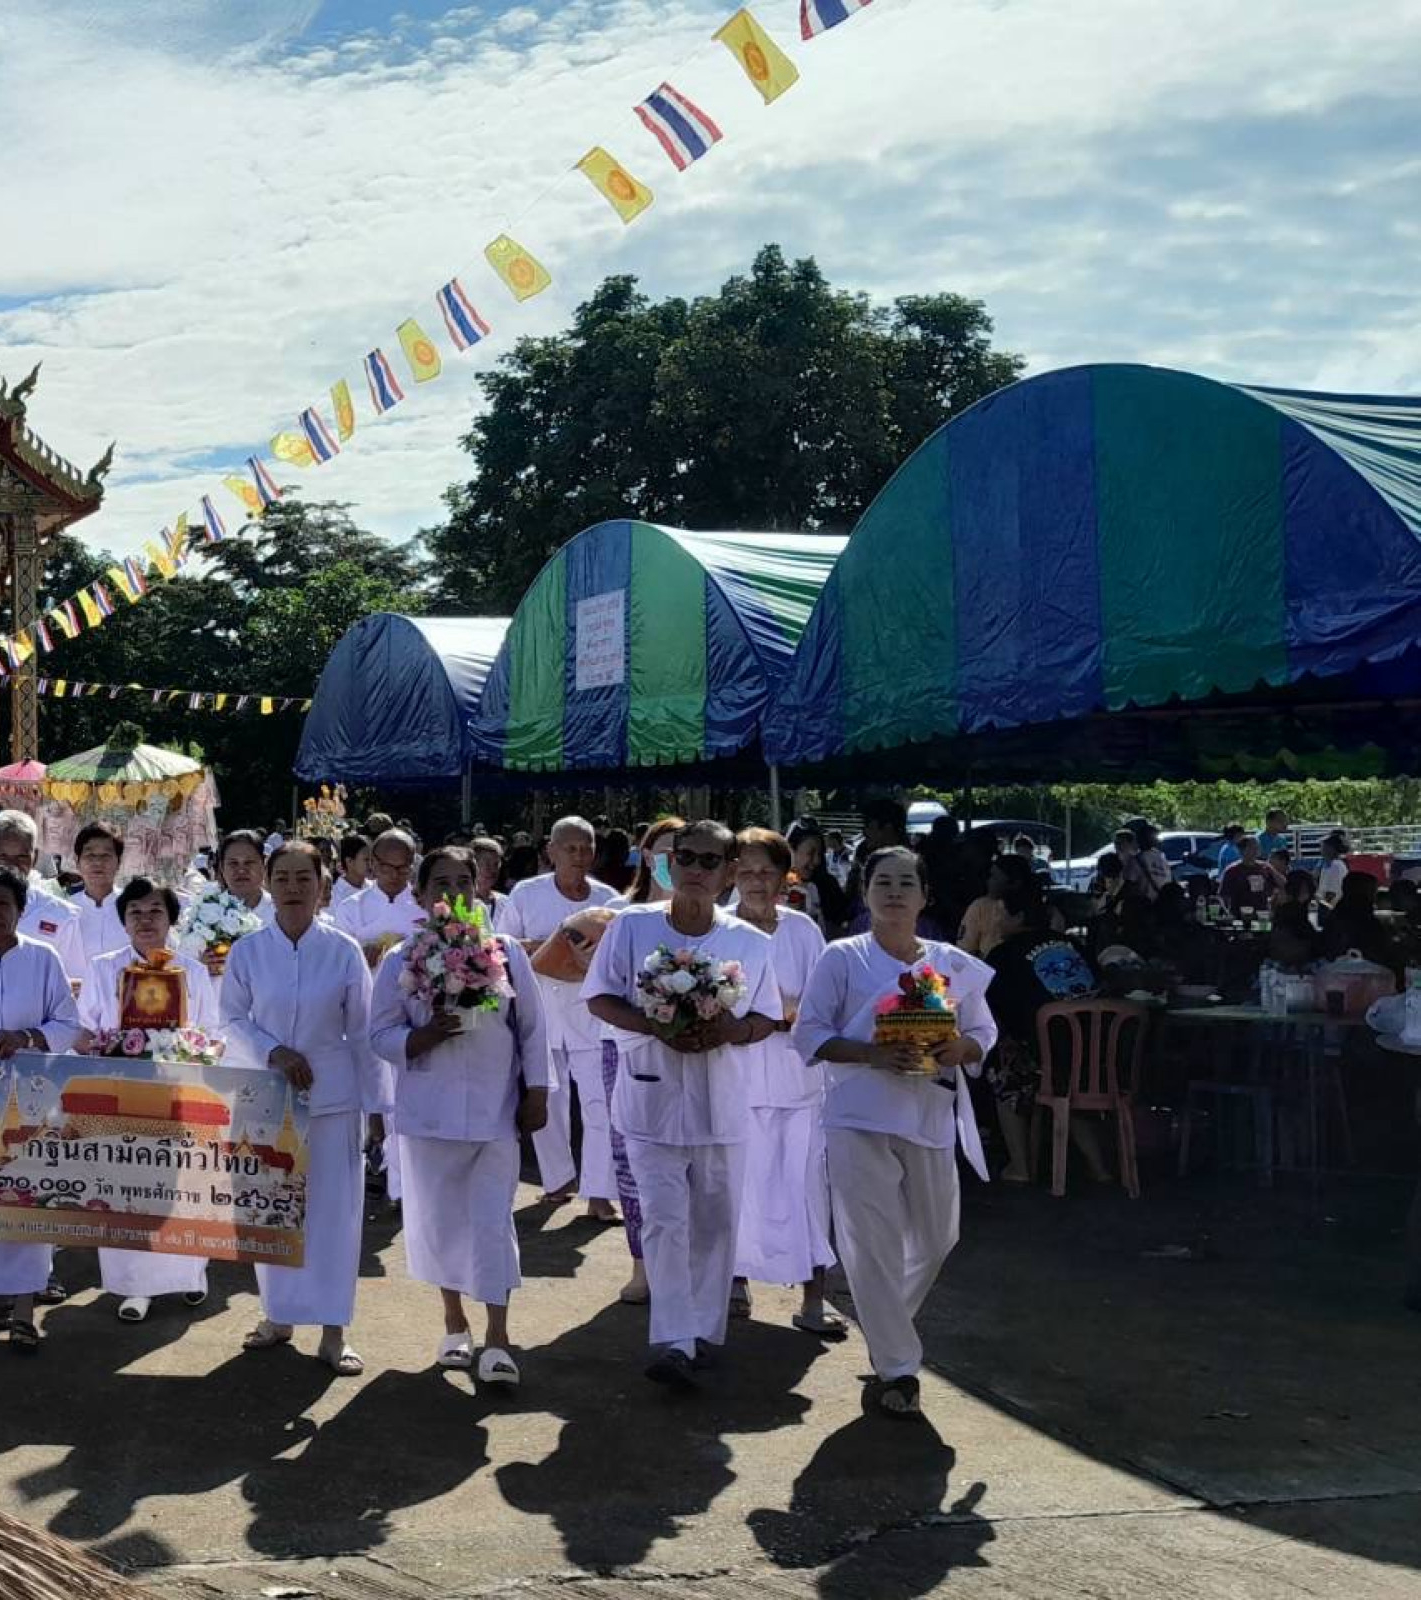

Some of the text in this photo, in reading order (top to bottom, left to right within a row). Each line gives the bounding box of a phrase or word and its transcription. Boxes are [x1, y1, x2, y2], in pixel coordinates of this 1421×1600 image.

[27, 1130, 260, 1176] กฐินสามัคคีทั่วไทย
[94, 1177, 114, 1196] วัด
[120, 1182, 201, 1204] พุทธศักราช
